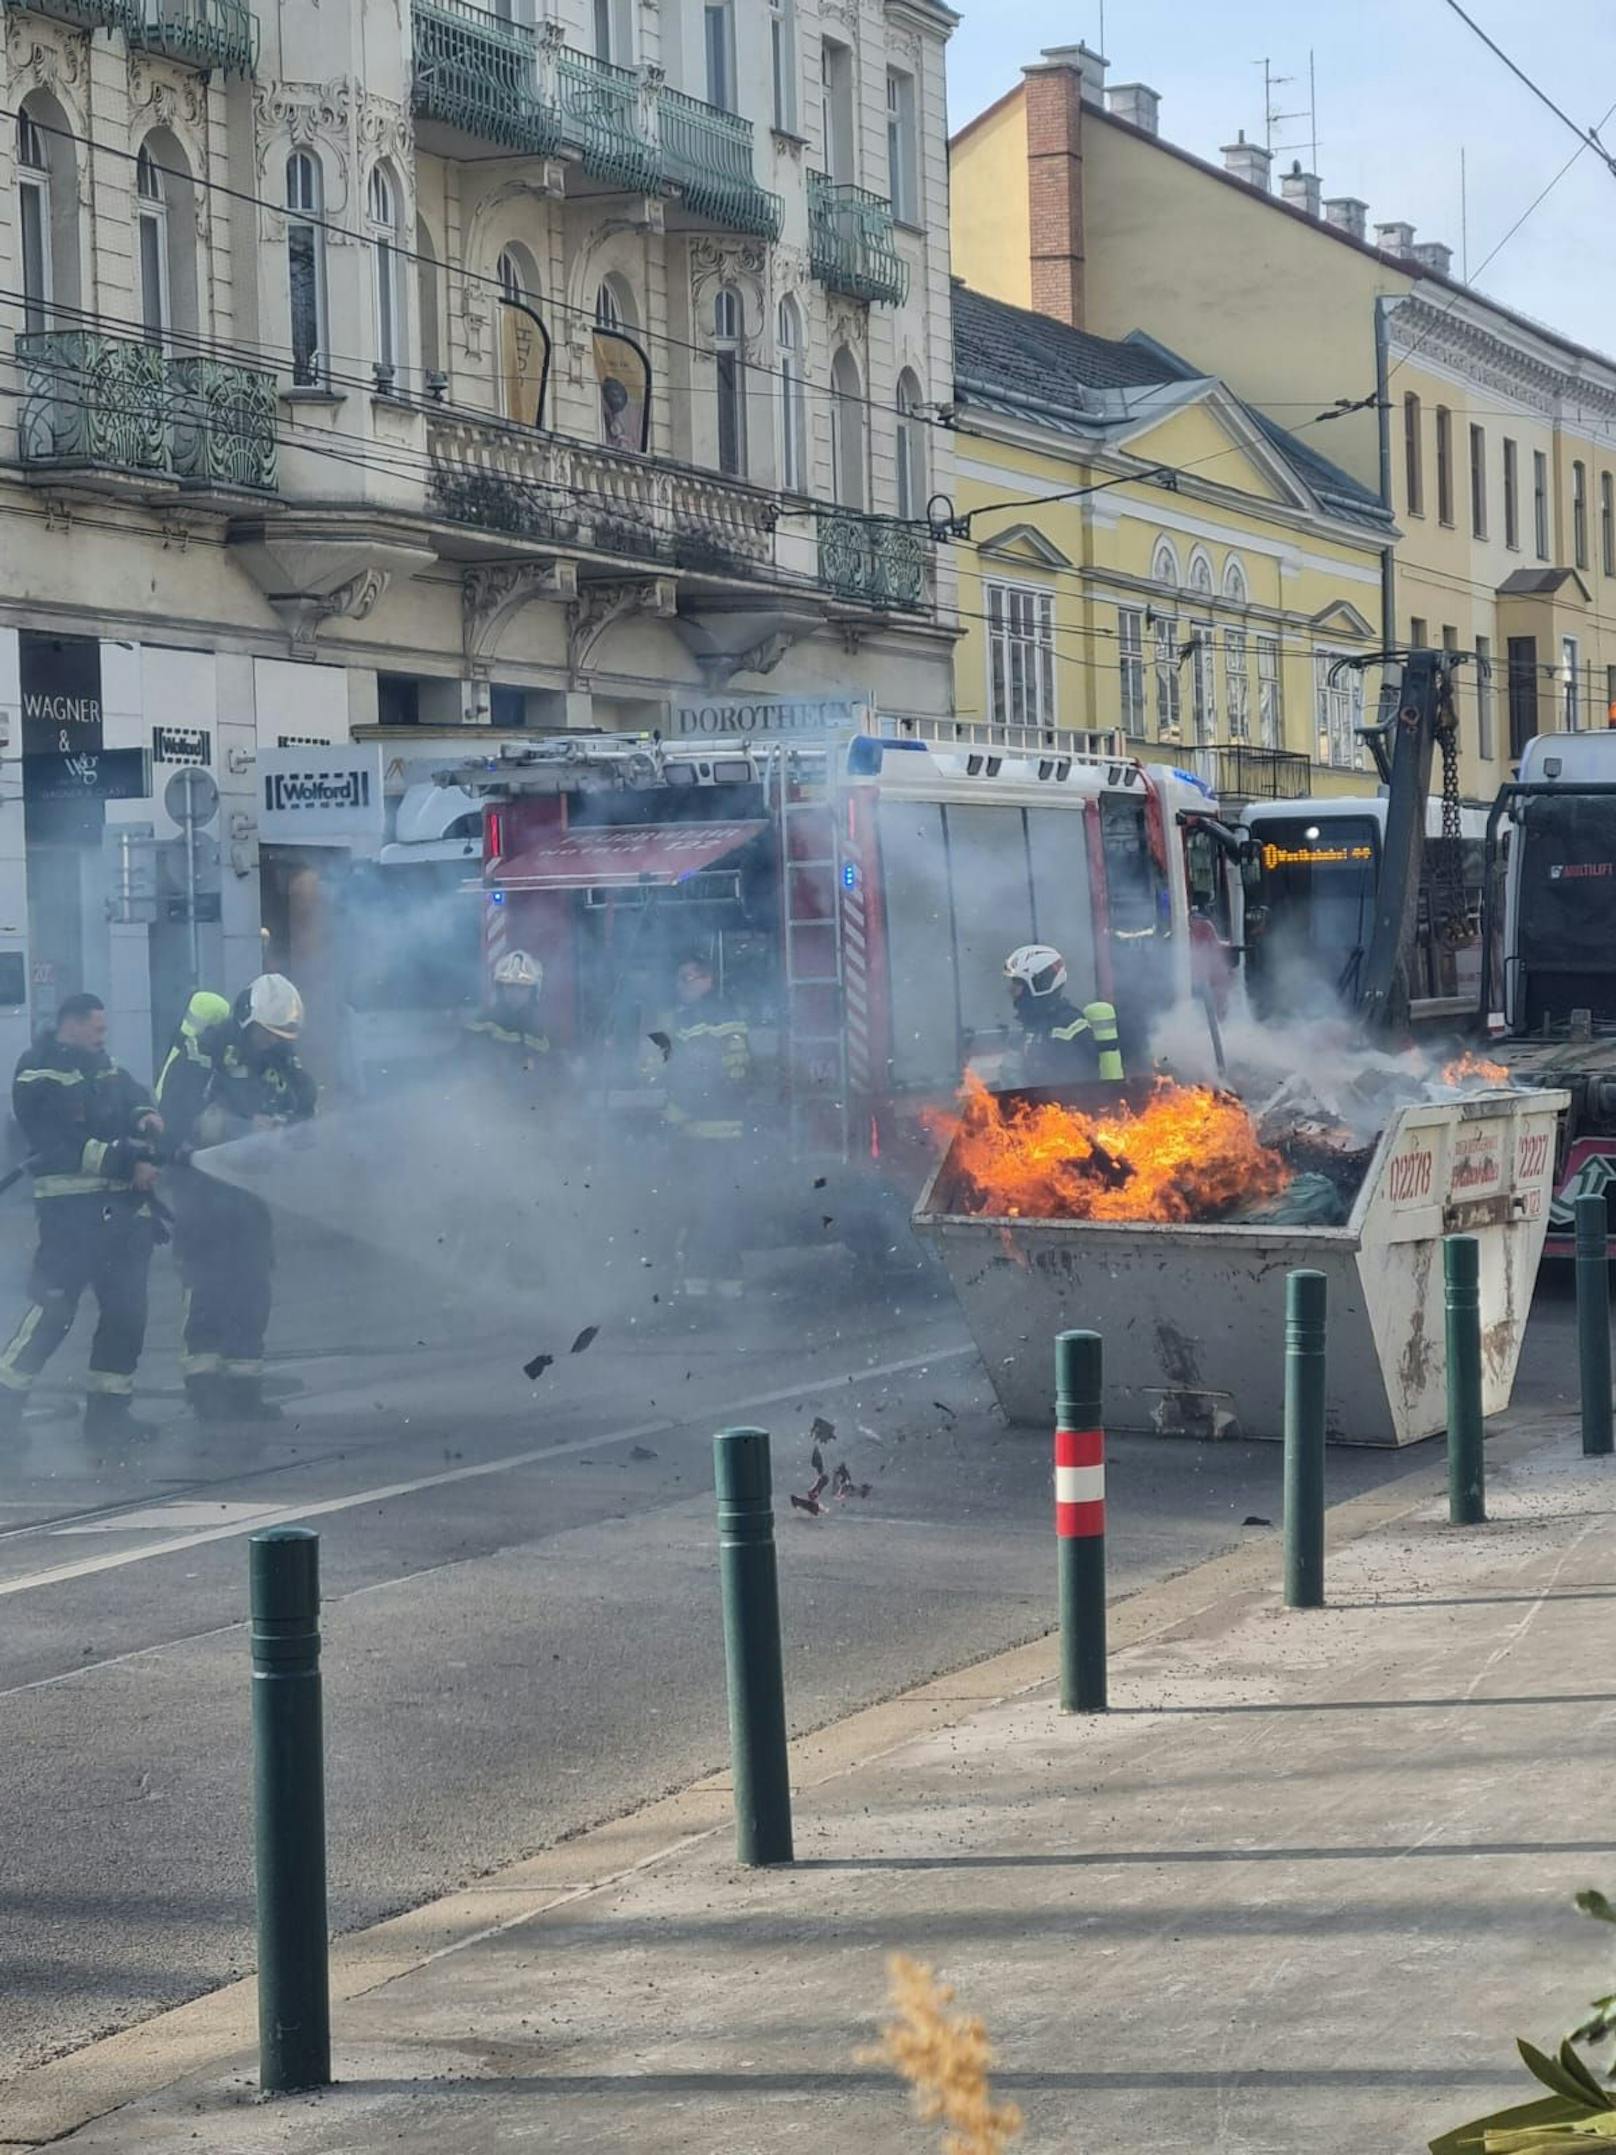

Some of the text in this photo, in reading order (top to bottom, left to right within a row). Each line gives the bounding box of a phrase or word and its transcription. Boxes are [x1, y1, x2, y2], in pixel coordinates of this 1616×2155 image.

[23, 693, 101, 723] WAGNER
[58, 729, 71, 752] &
[162, 735, 202, 757] Wolford
[283, 780, 352, 801] Wolford
[663, 839, 722, 851] 122
